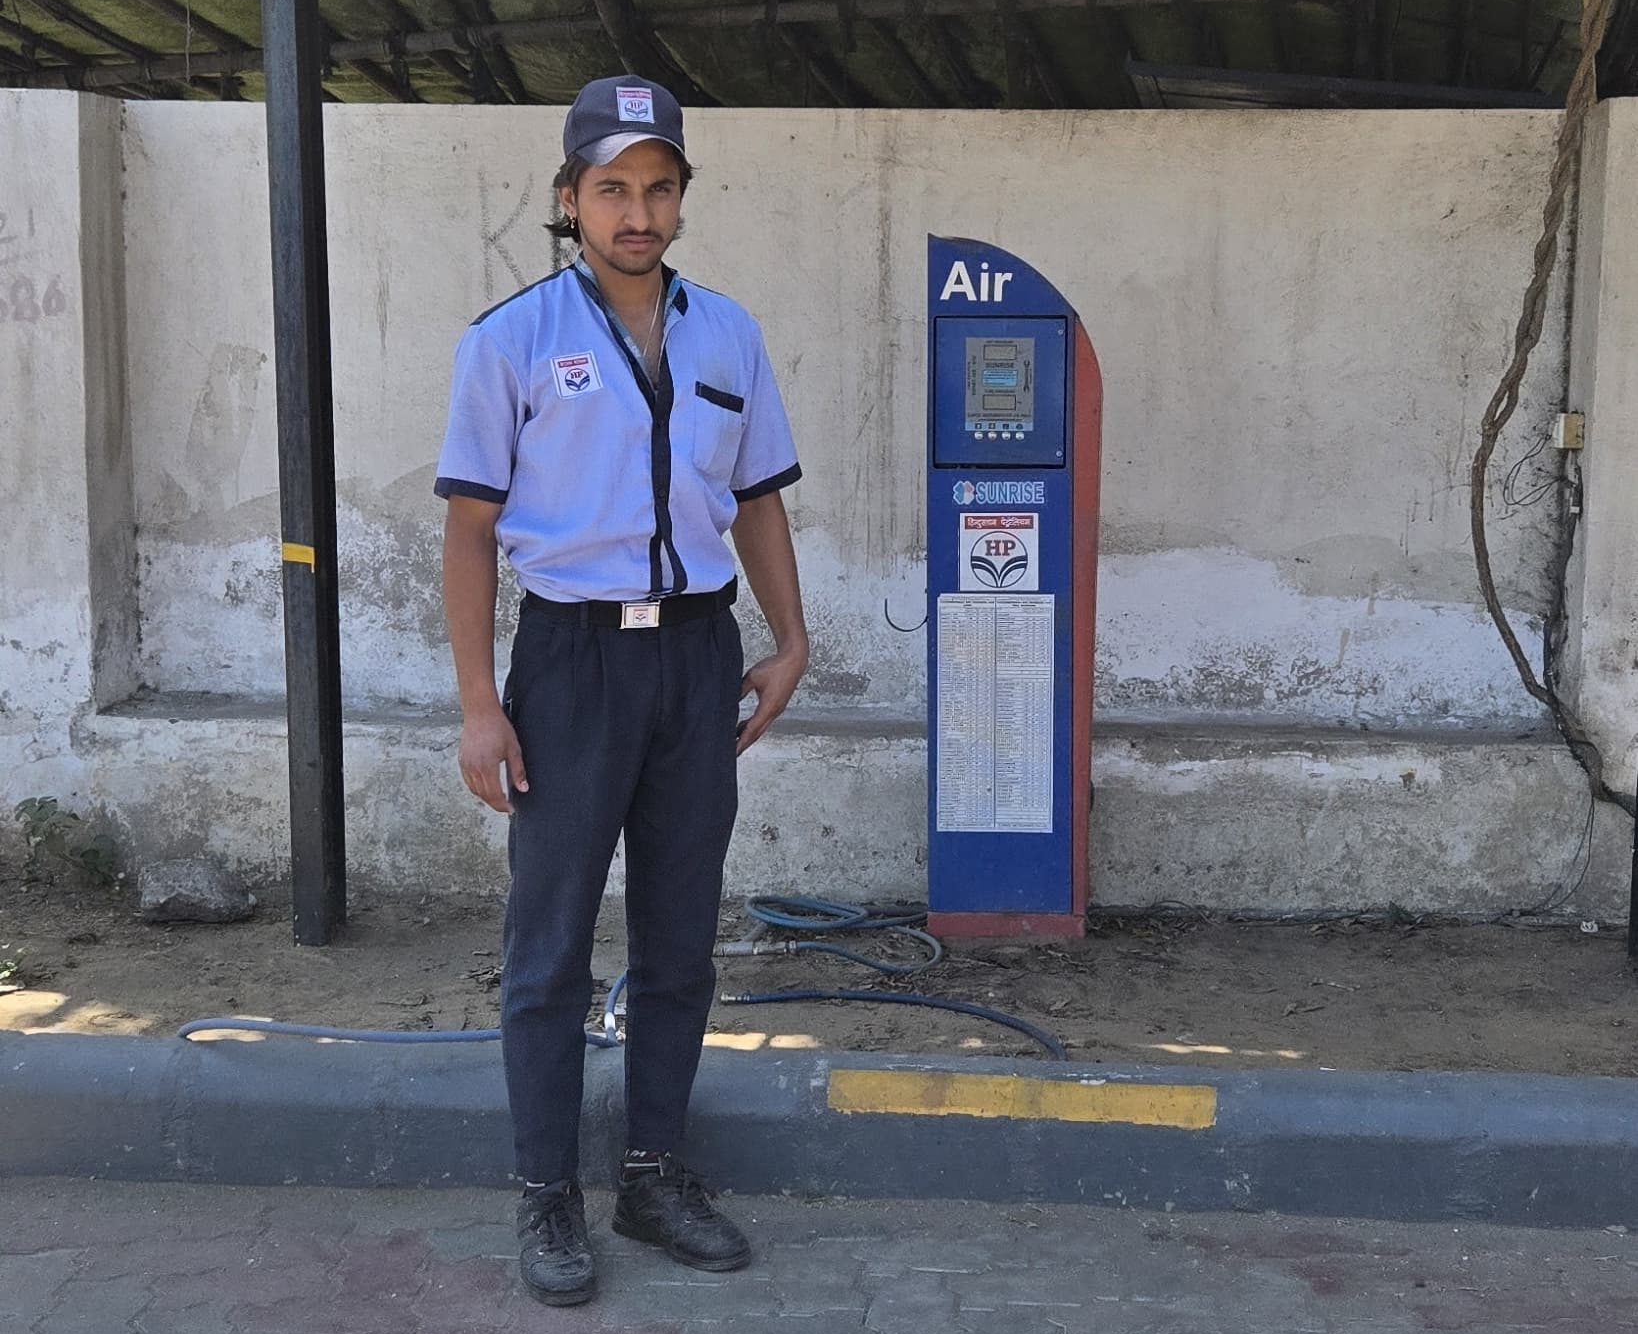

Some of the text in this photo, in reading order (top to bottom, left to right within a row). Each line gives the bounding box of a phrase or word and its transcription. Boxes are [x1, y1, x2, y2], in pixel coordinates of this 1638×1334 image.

[940, 260, 1012, 302] Air
[975, 481, 1045, 505] SUNRISE
[984, 539, 1016, 556] HP
